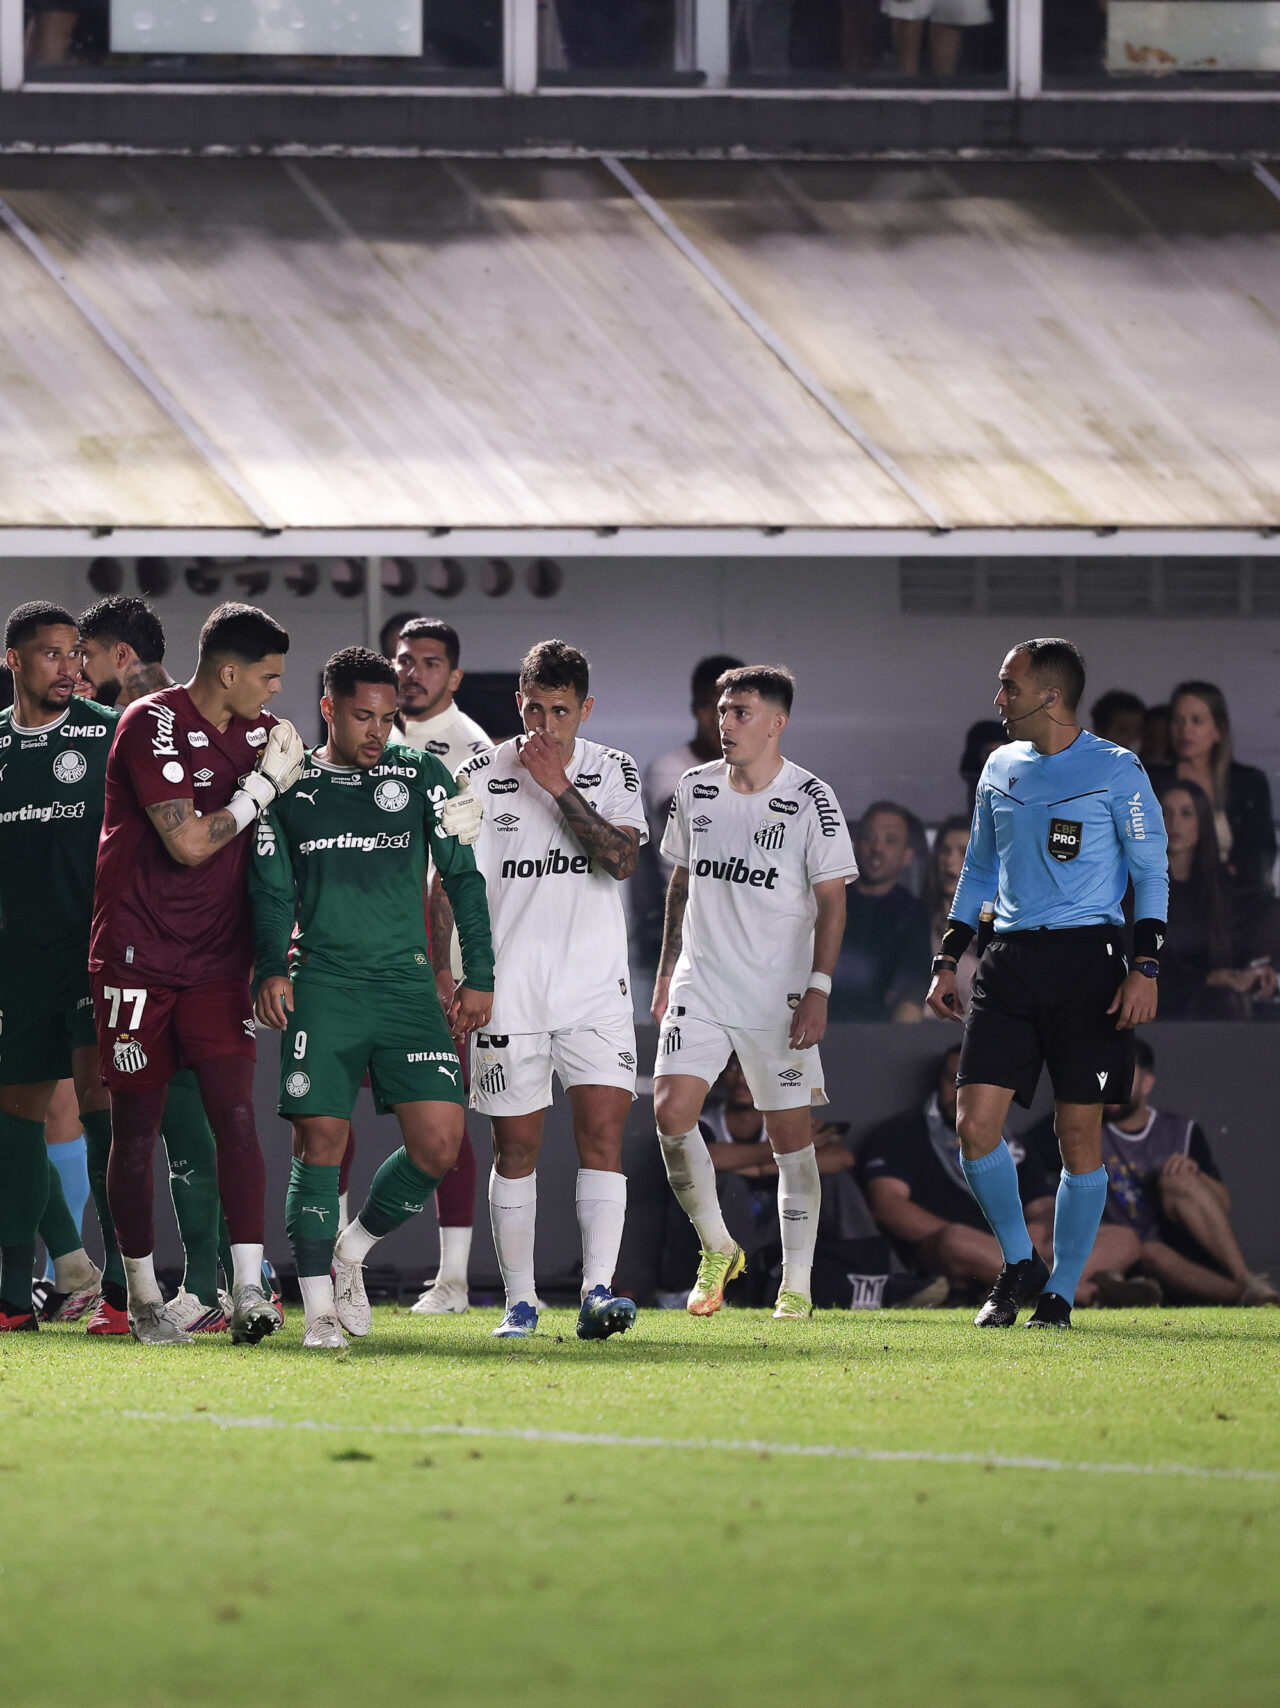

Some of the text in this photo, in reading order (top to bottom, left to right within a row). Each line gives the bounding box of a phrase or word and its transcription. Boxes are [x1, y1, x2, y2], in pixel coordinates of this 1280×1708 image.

[60, 725, 107, 738] CIMED
[368, 765, 417, 778] CIMED
[488, 782, 518, 791] Canção
[694, 786, 719, 797] Canção
[770, 800, 798, 813] Canção
[798, 778, 840, 837] Kicaldo
[1054, 823, 1078, 834] CBF
[299, 831, 410, 855] sportingbet
[1053, 833, 1077, 845] PRO
[104, 985, 147, 1030] 77
[293, 1031, 308, 1060] 9
